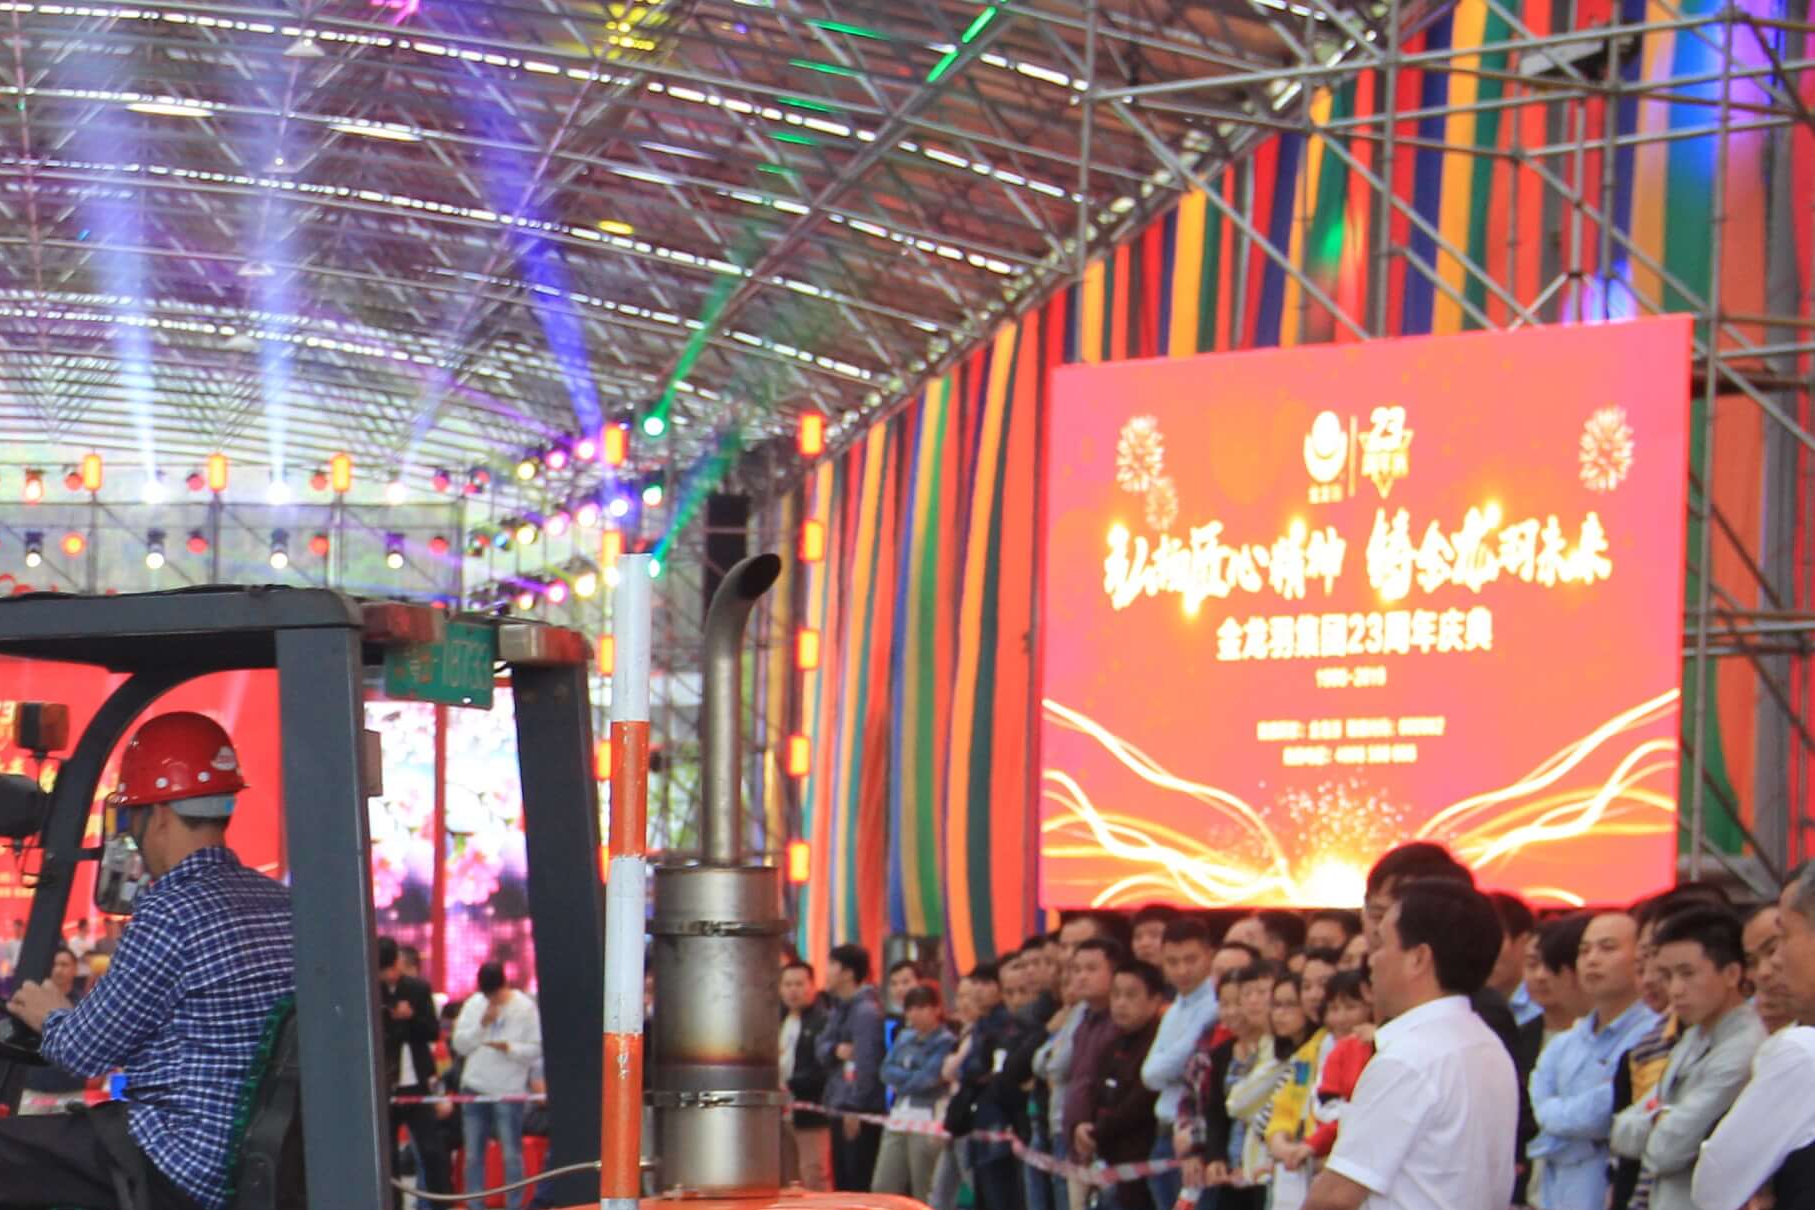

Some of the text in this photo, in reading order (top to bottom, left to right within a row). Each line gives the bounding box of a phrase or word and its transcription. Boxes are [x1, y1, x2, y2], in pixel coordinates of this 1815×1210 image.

[1217, 607, 1494, 661] 金龙羽集团23周年庆典
